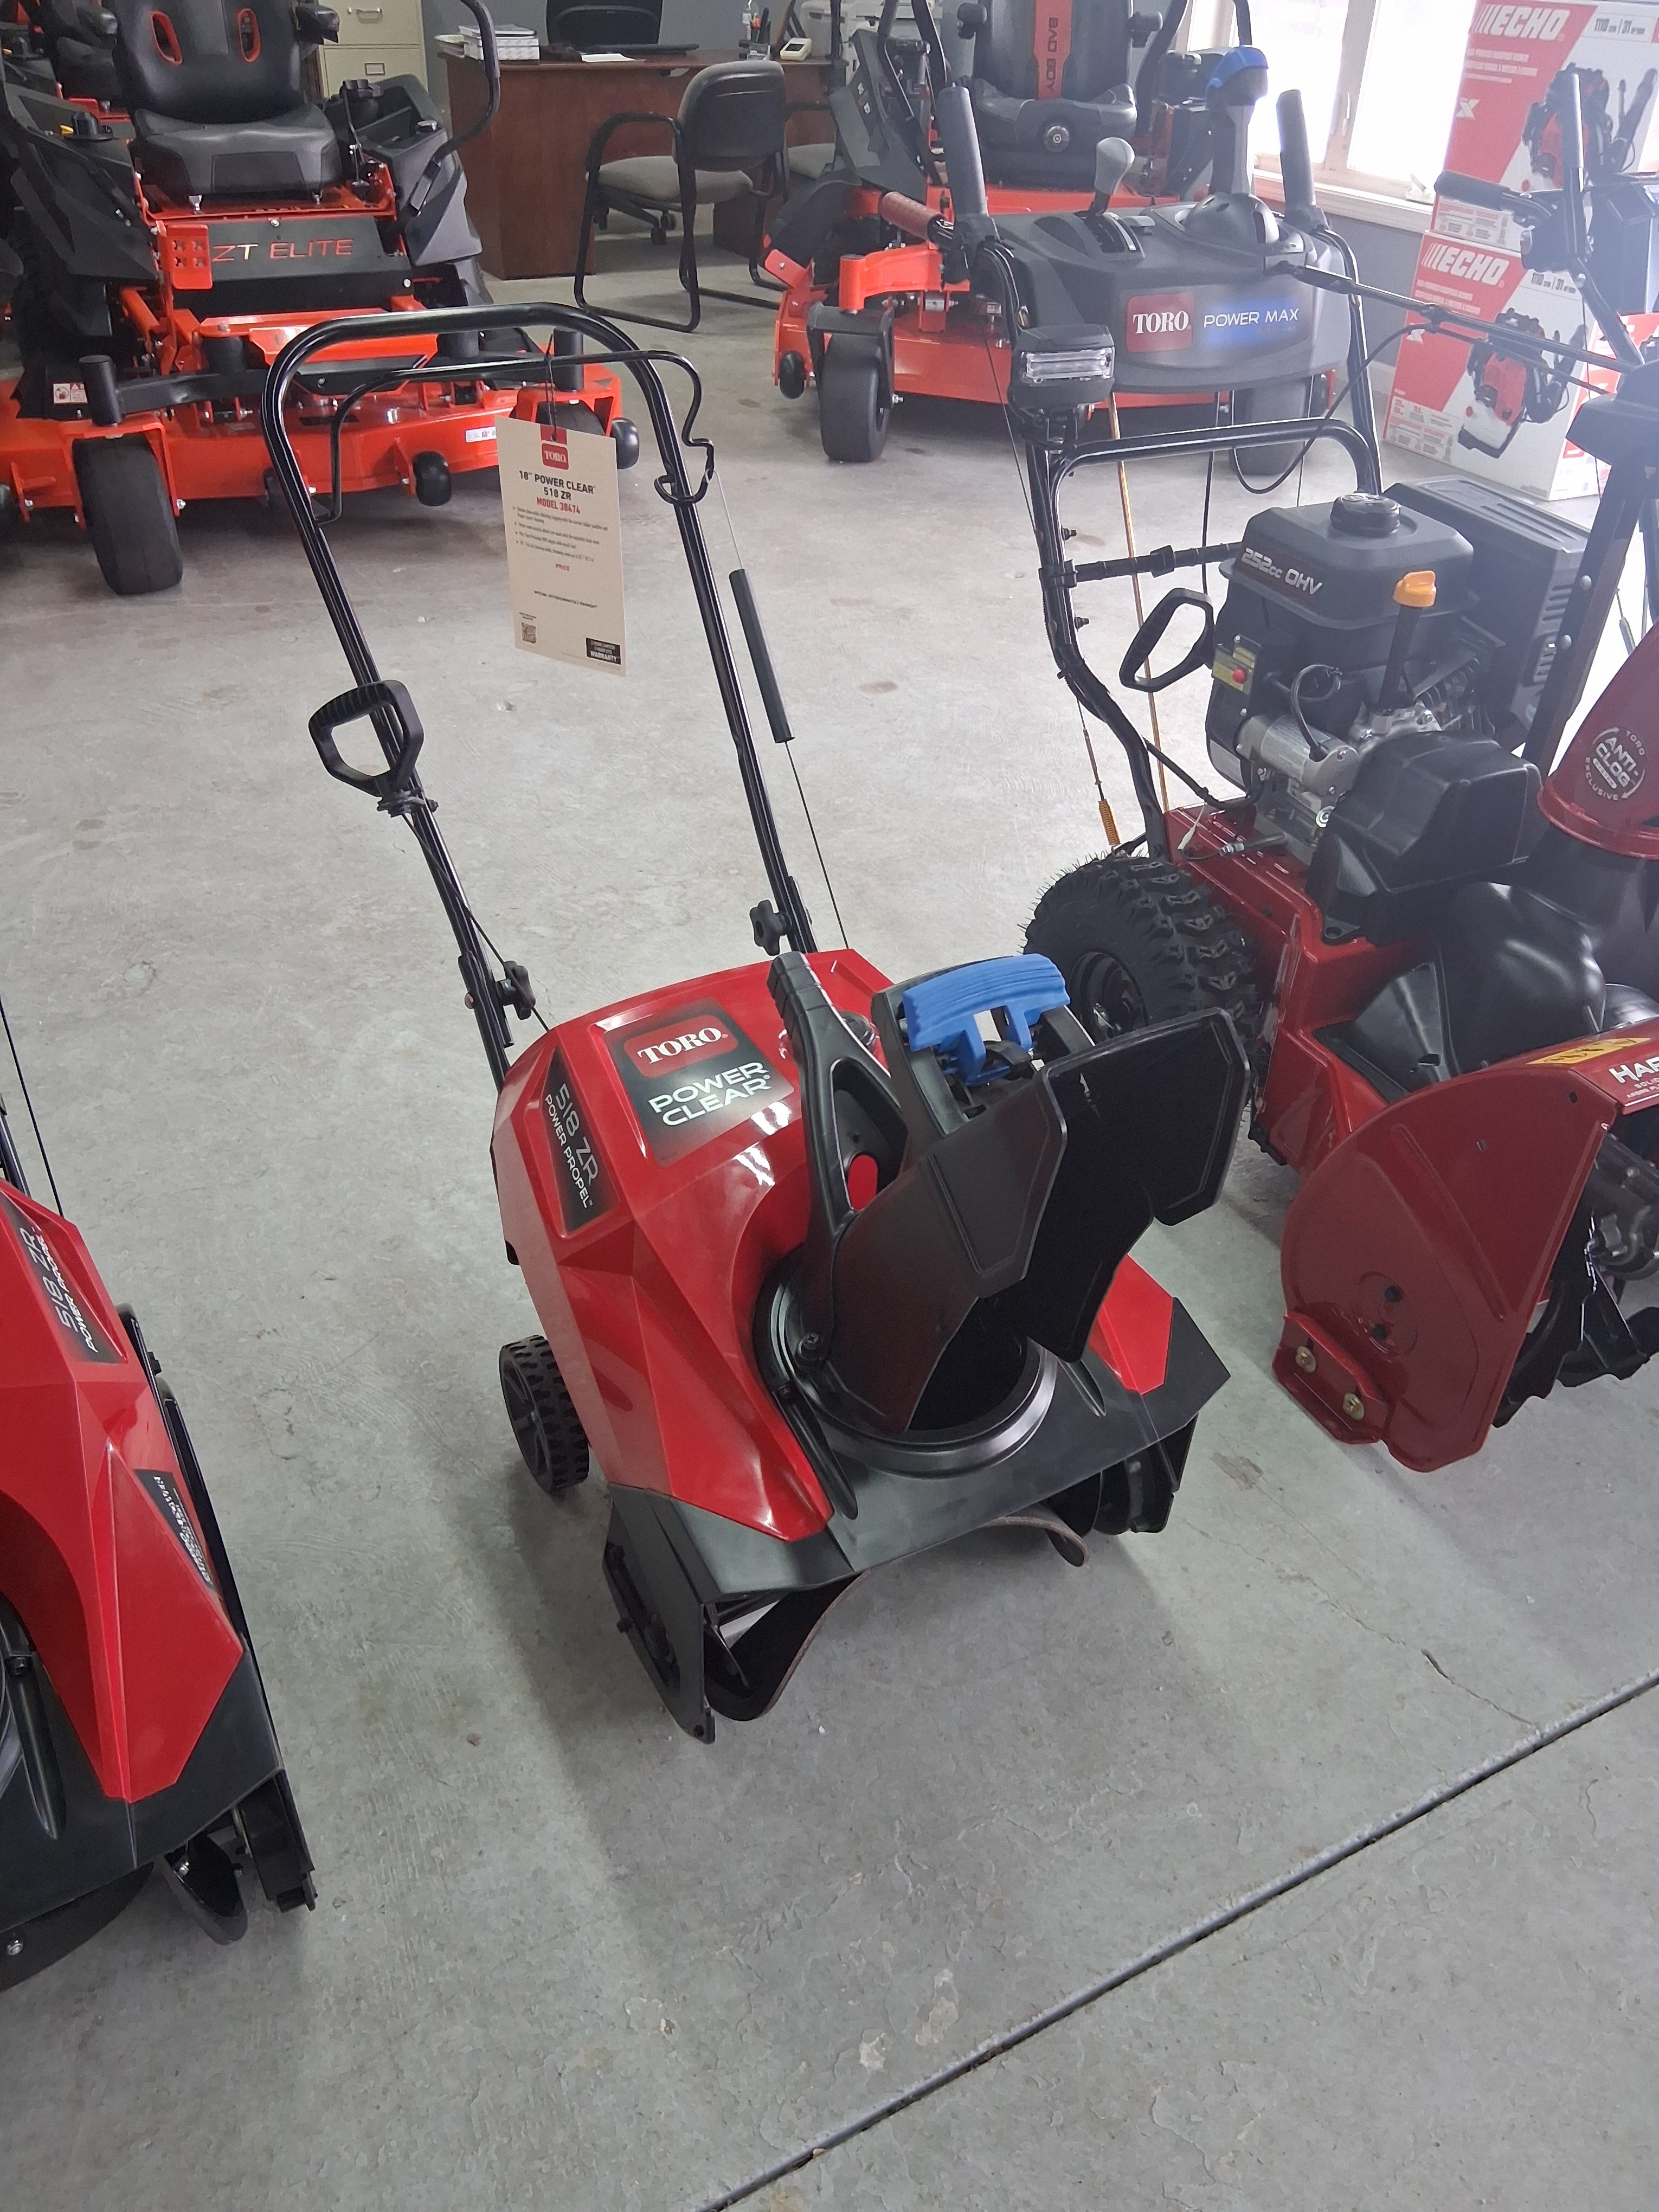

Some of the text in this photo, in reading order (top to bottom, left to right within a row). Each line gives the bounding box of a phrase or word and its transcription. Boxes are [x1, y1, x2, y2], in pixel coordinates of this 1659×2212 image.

[1488, 4, 1570, 41] ECHO
[1046, 17, 1058, 92] BAD BOY
[212, 239, 354, 262] ZT ELITE
[1437, 247, 1509, 286] ECHO
[1133, 311, 1189, 334] TORO
[1204, 308, 1300, 328] POWER MAX
[534, 473, 564, 488] POWER
[561, 490, 571, 501] ZR
[537, 497, 558, 510] MODEL
[1242, 548, 1323, 595] 252cc OHV
[1626, 730, 1645, 756] TORO
[1596, 743, 1630, 787] CLOG
[637, 1027, 722, 1064] TORO
[648, 1062, 769, 1114] POWER
[662, 1078, 773, 1126] CLEAR
[545, 1094, 590, 1208] POWER PROPEL
[556, 1083, 599, 1186] 518 ZR
[20, 1227, 79, 1333] 518 ZR
[65, 1293, 99, 1353] POWER
